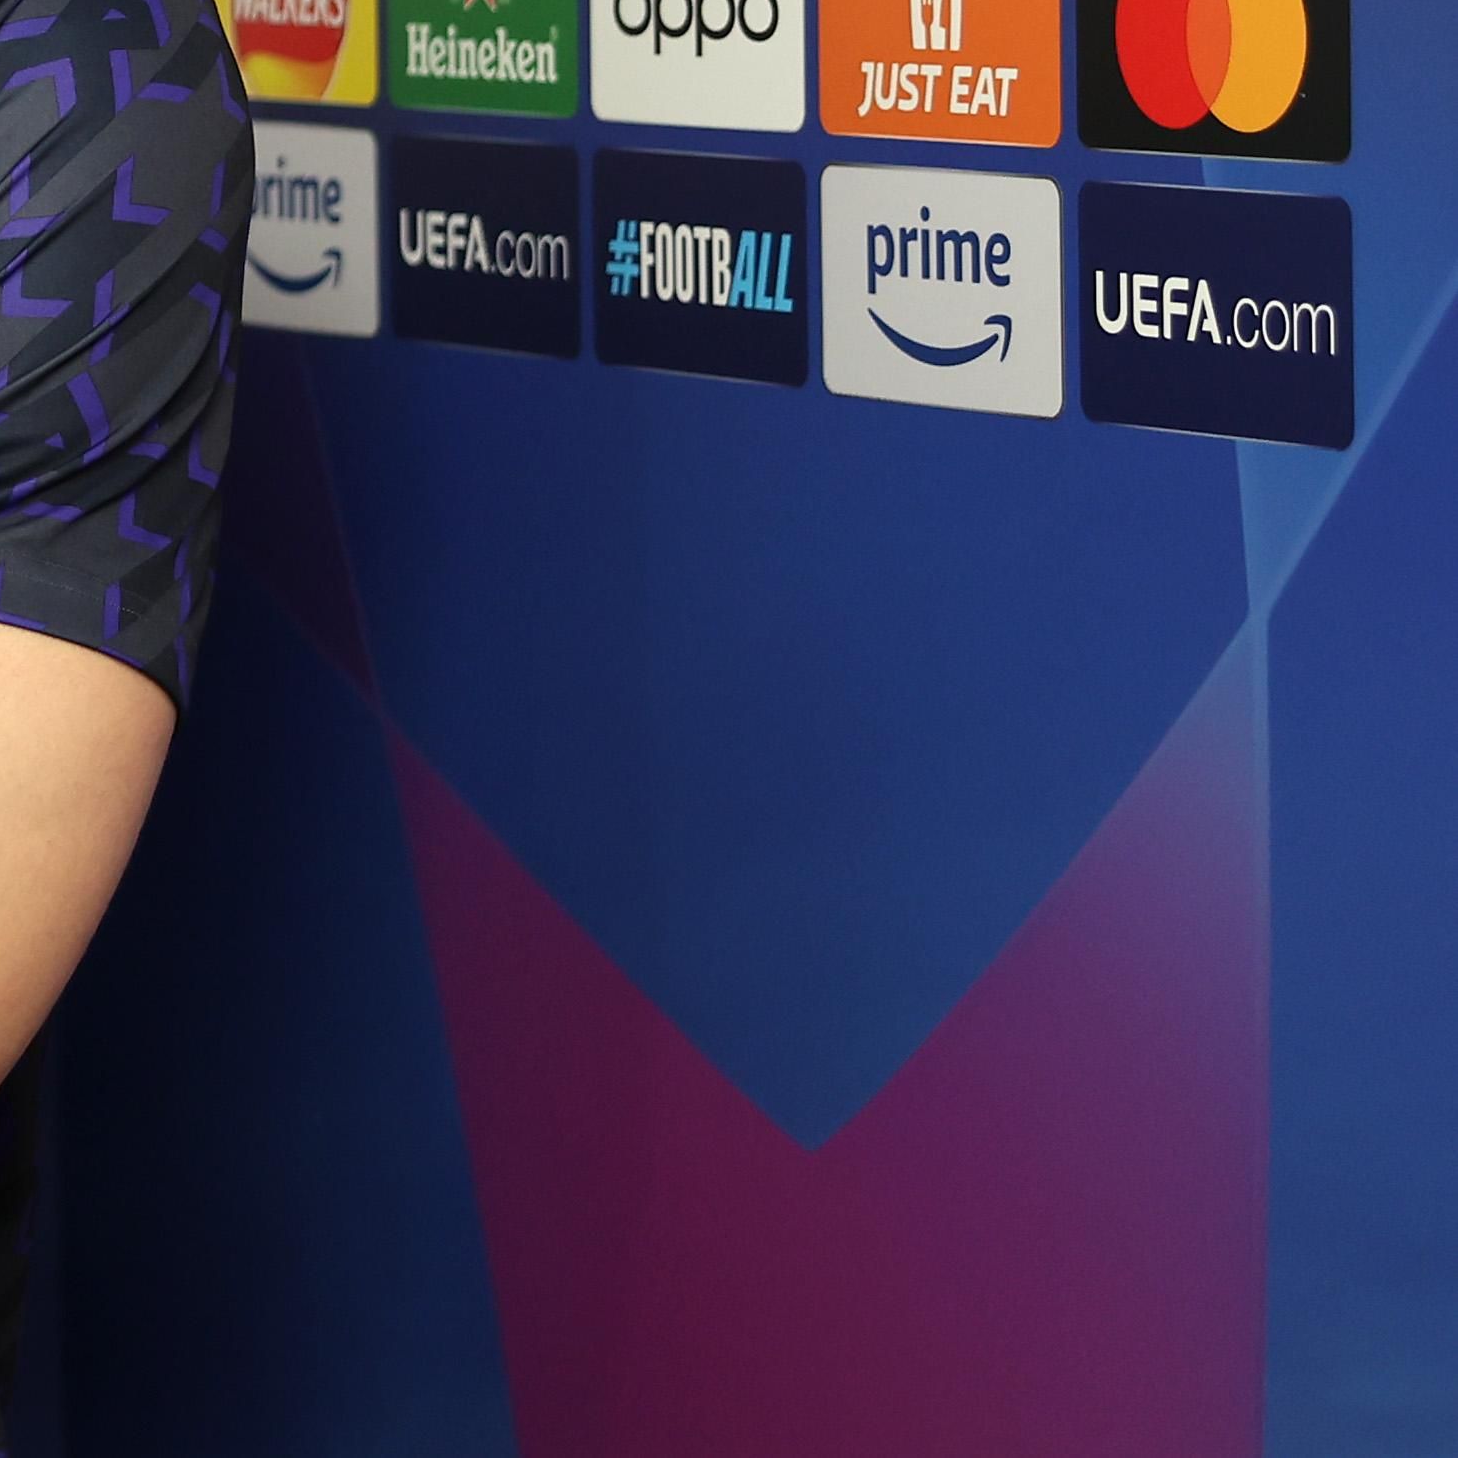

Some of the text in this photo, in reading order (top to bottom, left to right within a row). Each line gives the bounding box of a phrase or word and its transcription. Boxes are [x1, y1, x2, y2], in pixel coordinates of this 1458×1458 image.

[406, 21, 558, 84] Heineken
[857, 61, 1019, 118] JUST EAT
[253, 155, 342, 224] rime
[399, 207, 569, 281] UEFA.com
[606, 219, 794, 315] #FOOTBALL
[867, 206, 1013, 295] prime
[1096, 270, 1338, 357] UEFA.com
